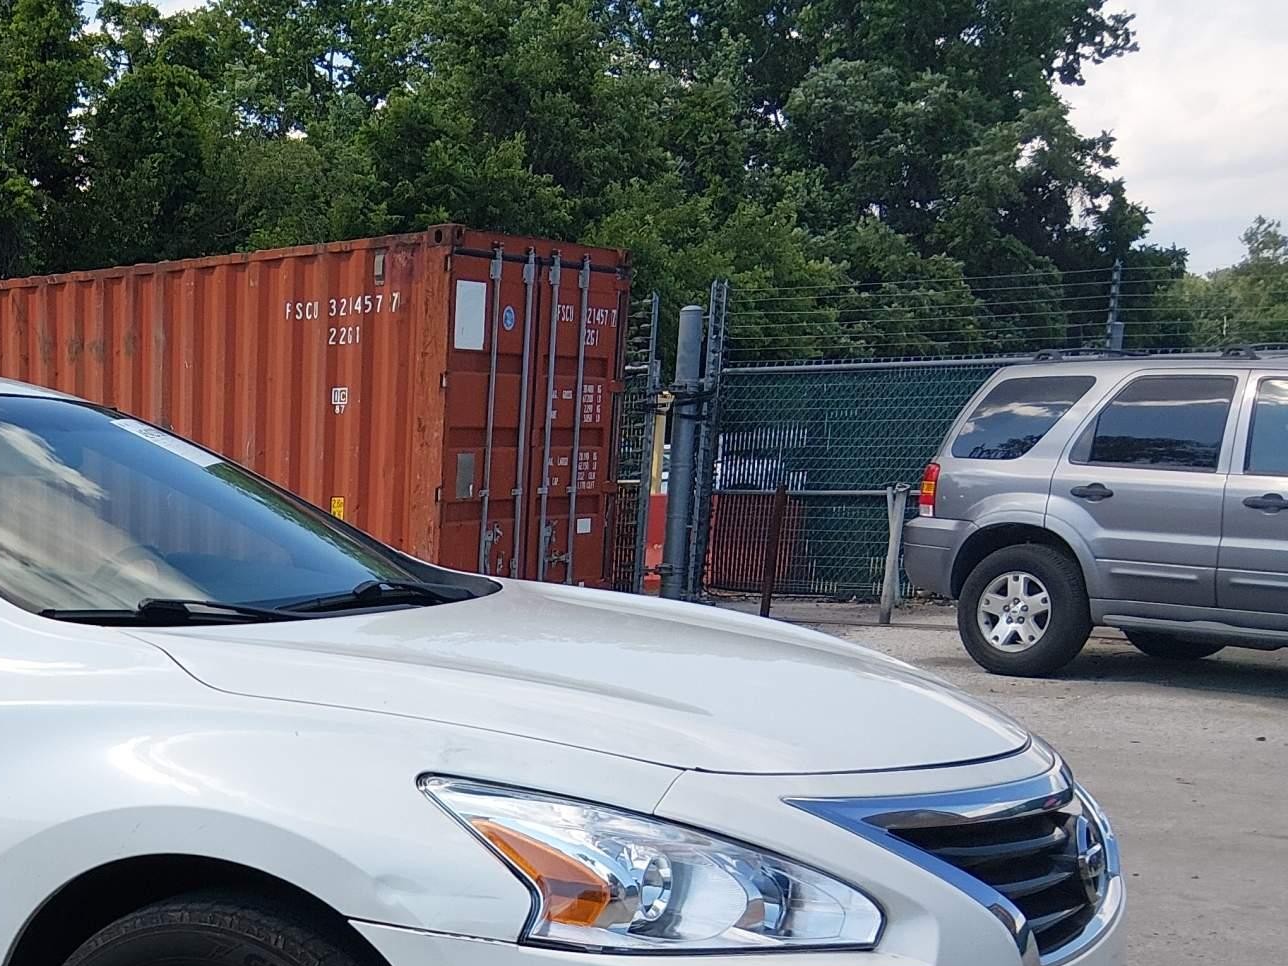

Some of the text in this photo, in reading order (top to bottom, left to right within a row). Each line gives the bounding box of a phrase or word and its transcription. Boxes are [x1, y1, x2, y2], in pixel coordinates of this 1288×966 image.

[285, 291, 400, 320] FSCU 321457 7
[557, 303, 574, 322] FSCU
[586, 307, 609, 327] 21457
